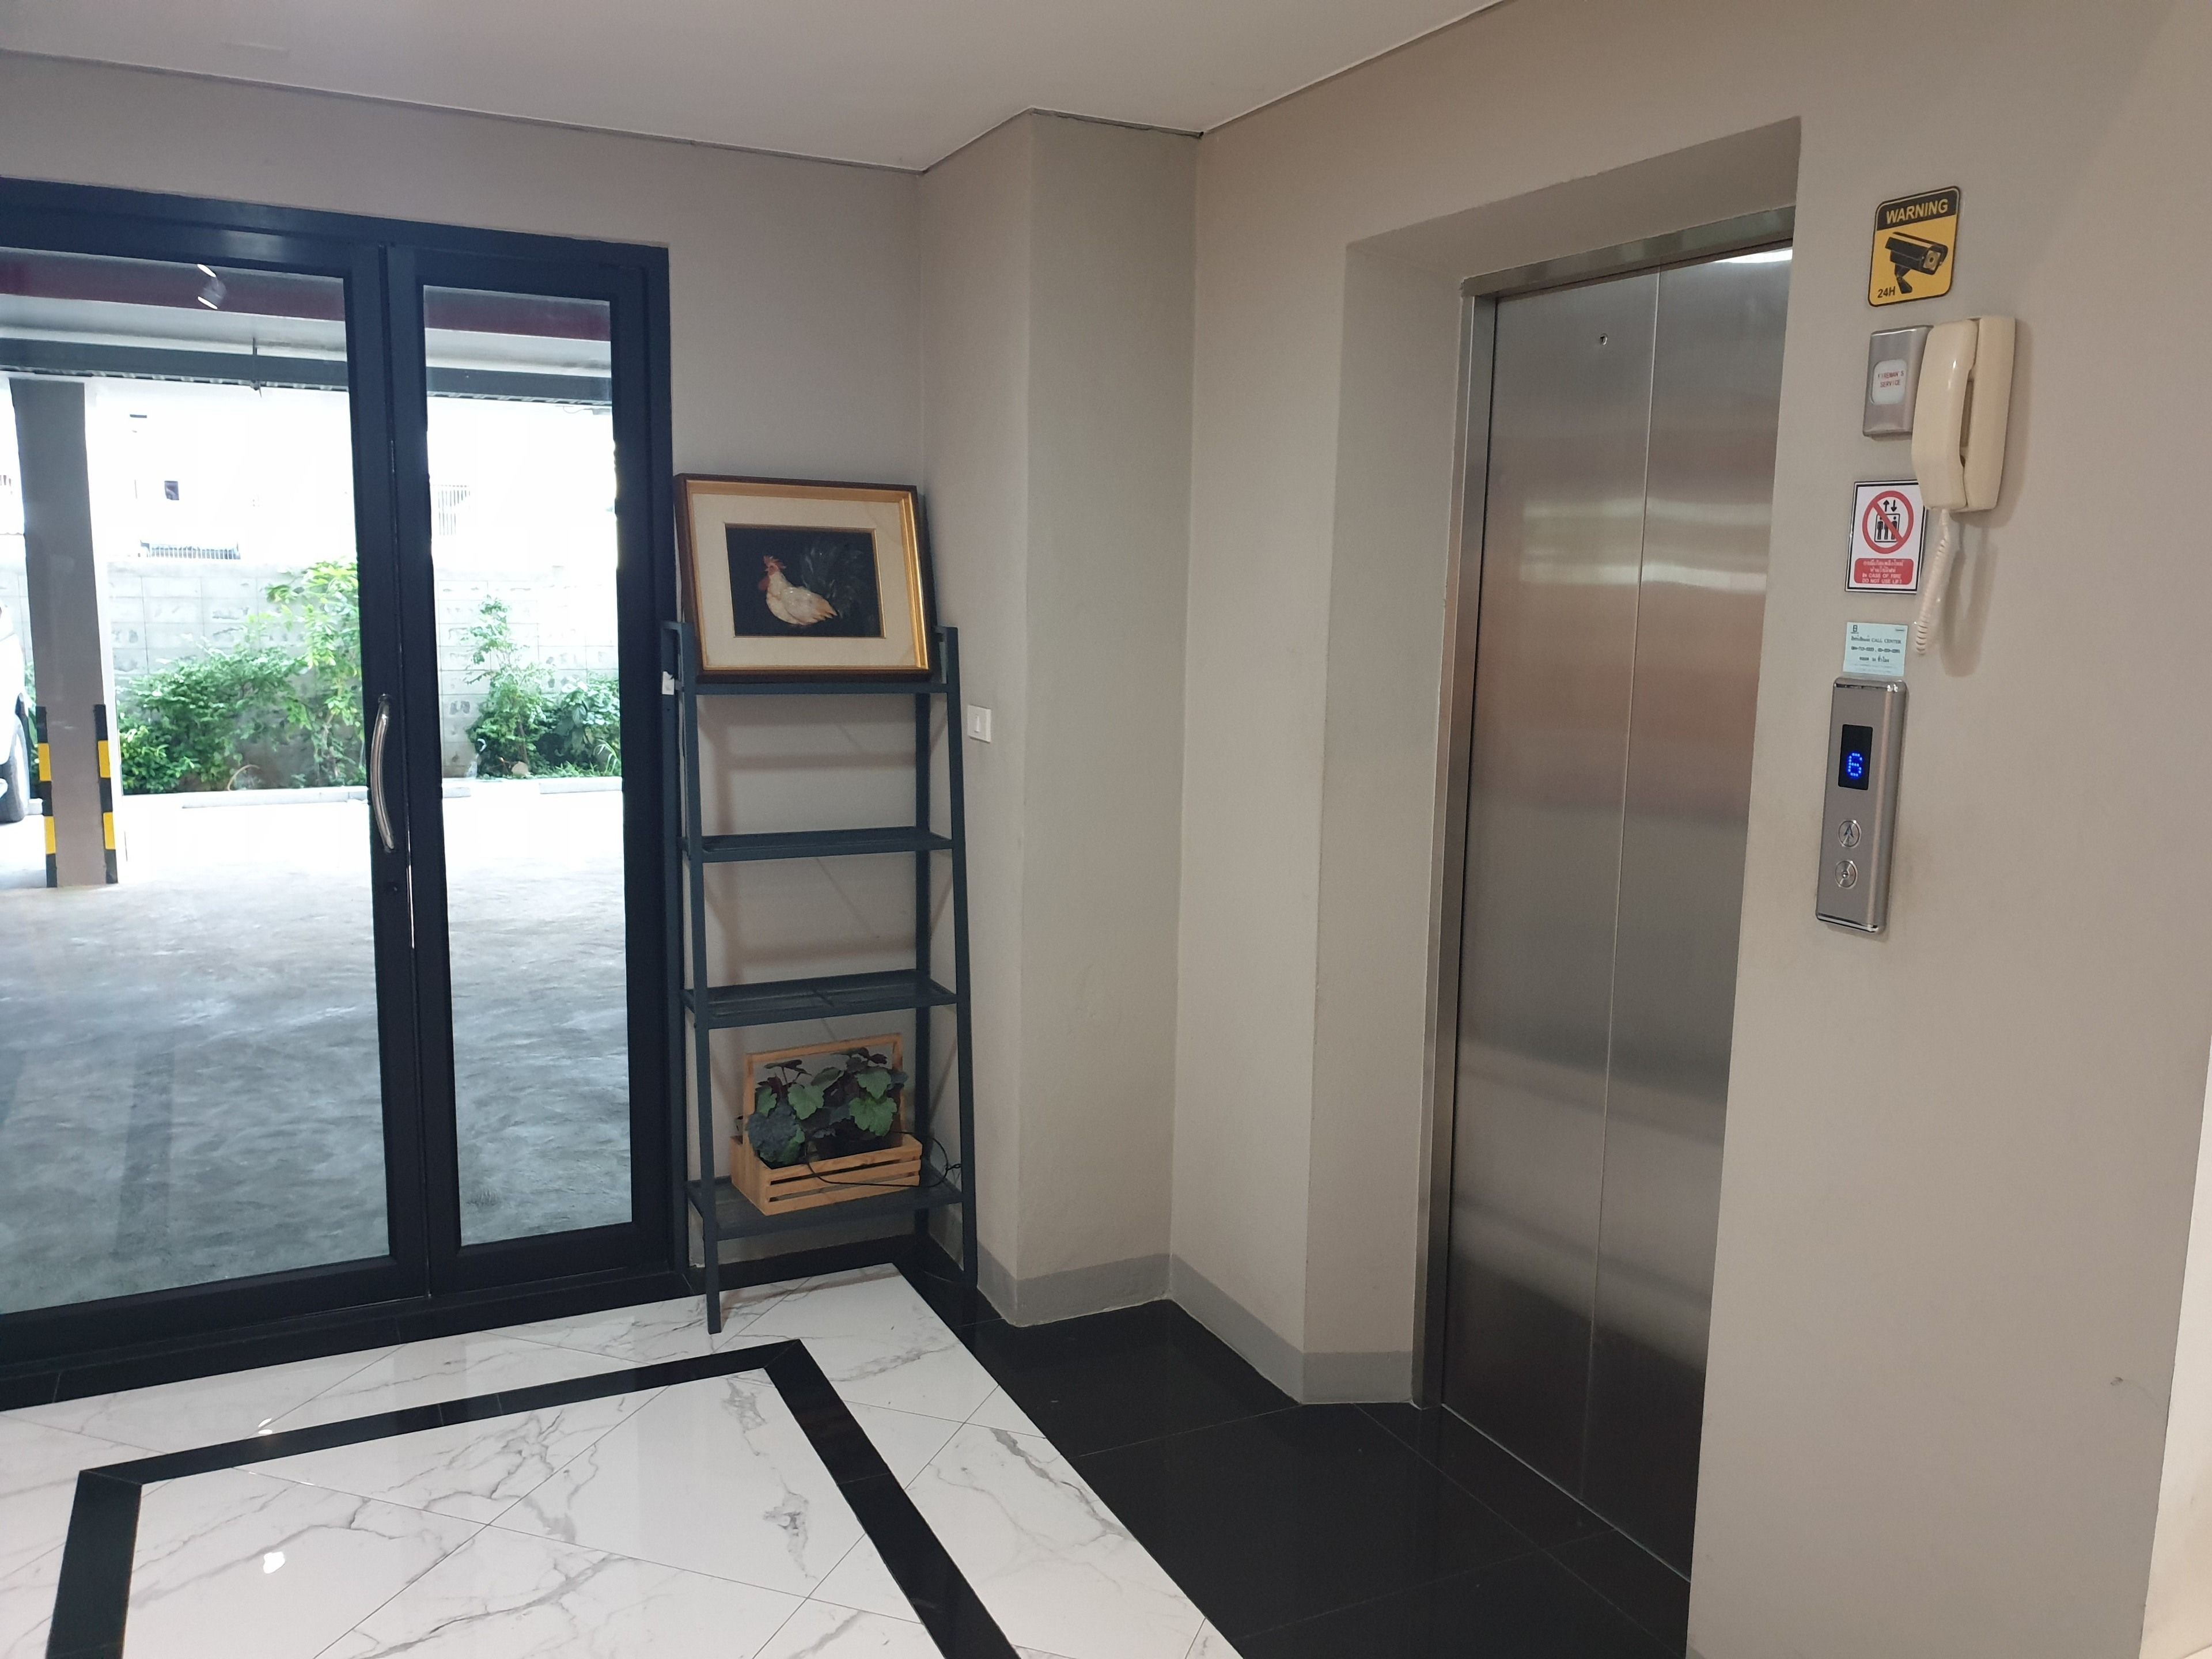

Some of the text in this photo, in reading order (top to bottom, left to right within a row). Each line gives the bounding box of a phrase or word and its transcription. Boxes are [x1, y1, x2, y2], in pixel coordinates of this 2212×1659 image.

[1886, 198, 1948, 225] WARNING
[1877, 286, 1896, 298] 24H
[1848, 752, 1862, 777] 6
